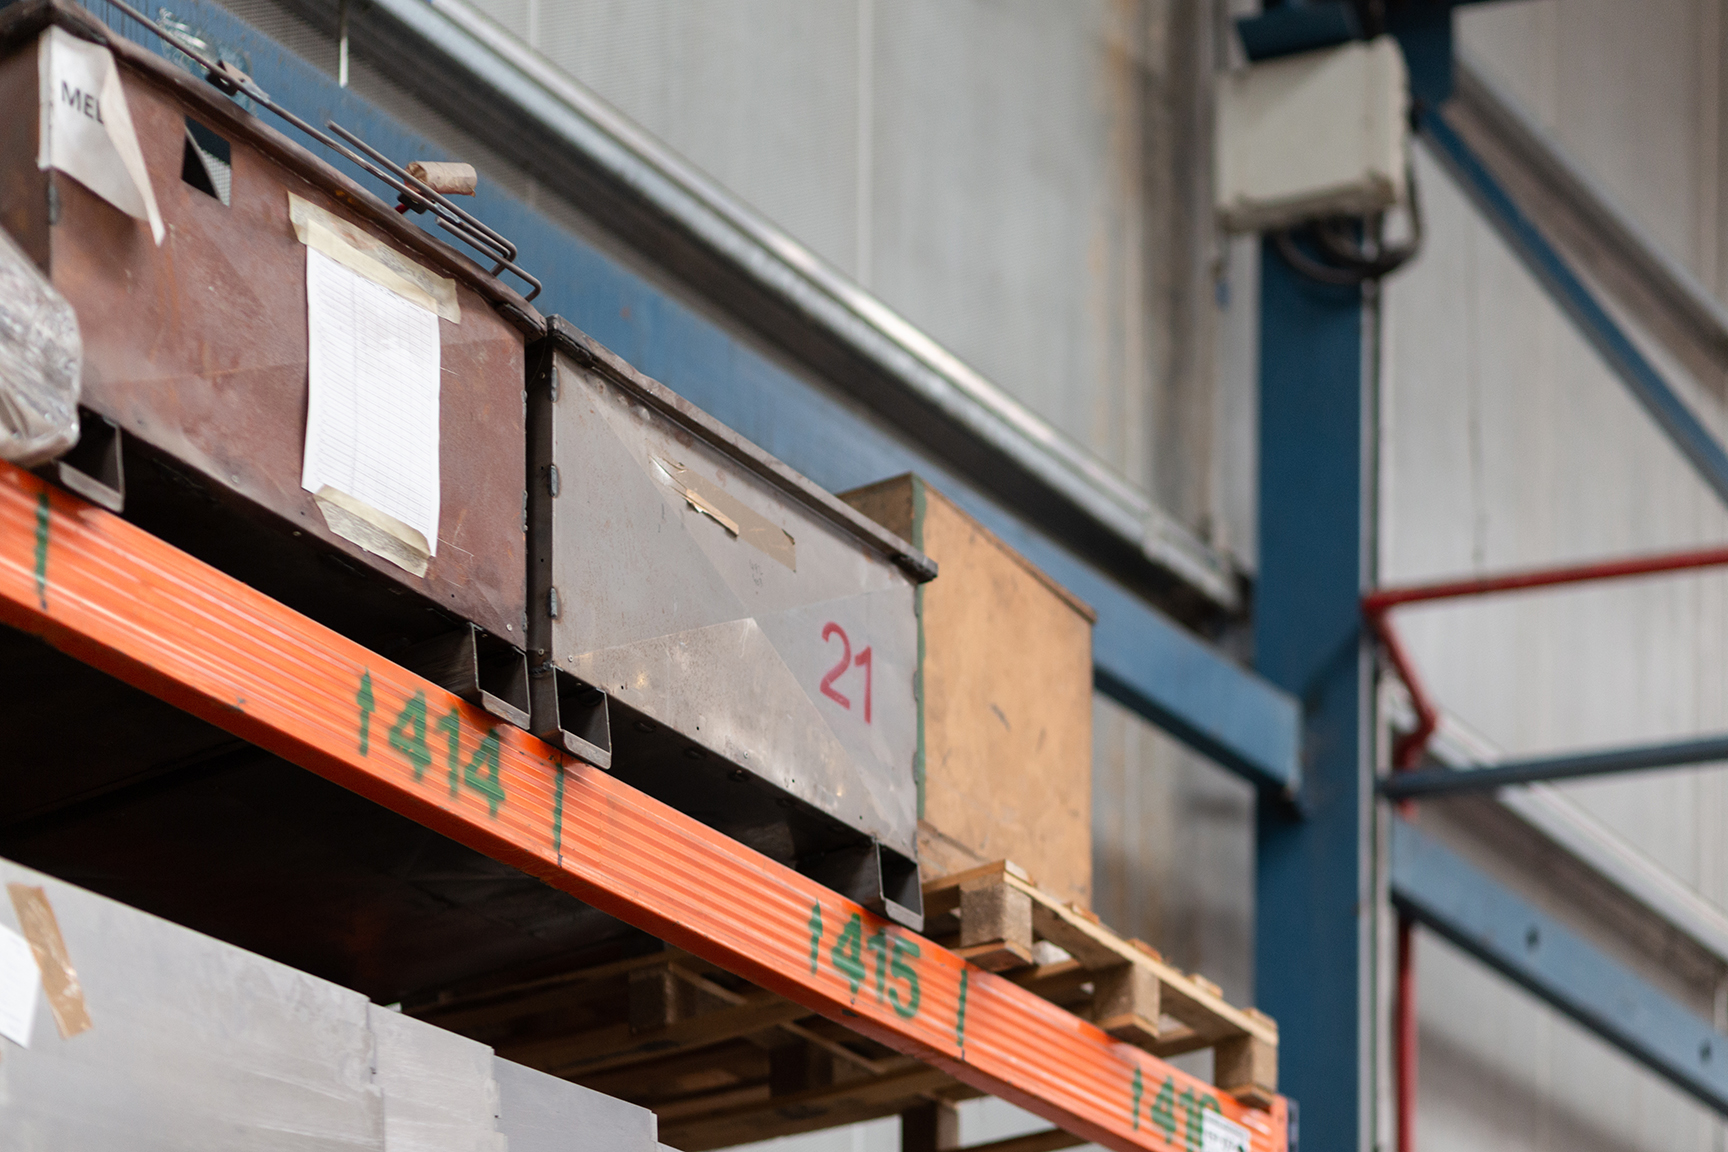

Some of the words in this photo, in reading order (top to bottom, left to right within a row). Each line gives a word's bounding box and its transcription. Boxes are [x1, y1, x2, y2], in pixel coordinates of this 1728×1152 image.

[820, 621, 872, 724] 21
[388, 688, 506, 820] 414
[831, 913, 921, 1018] 415
